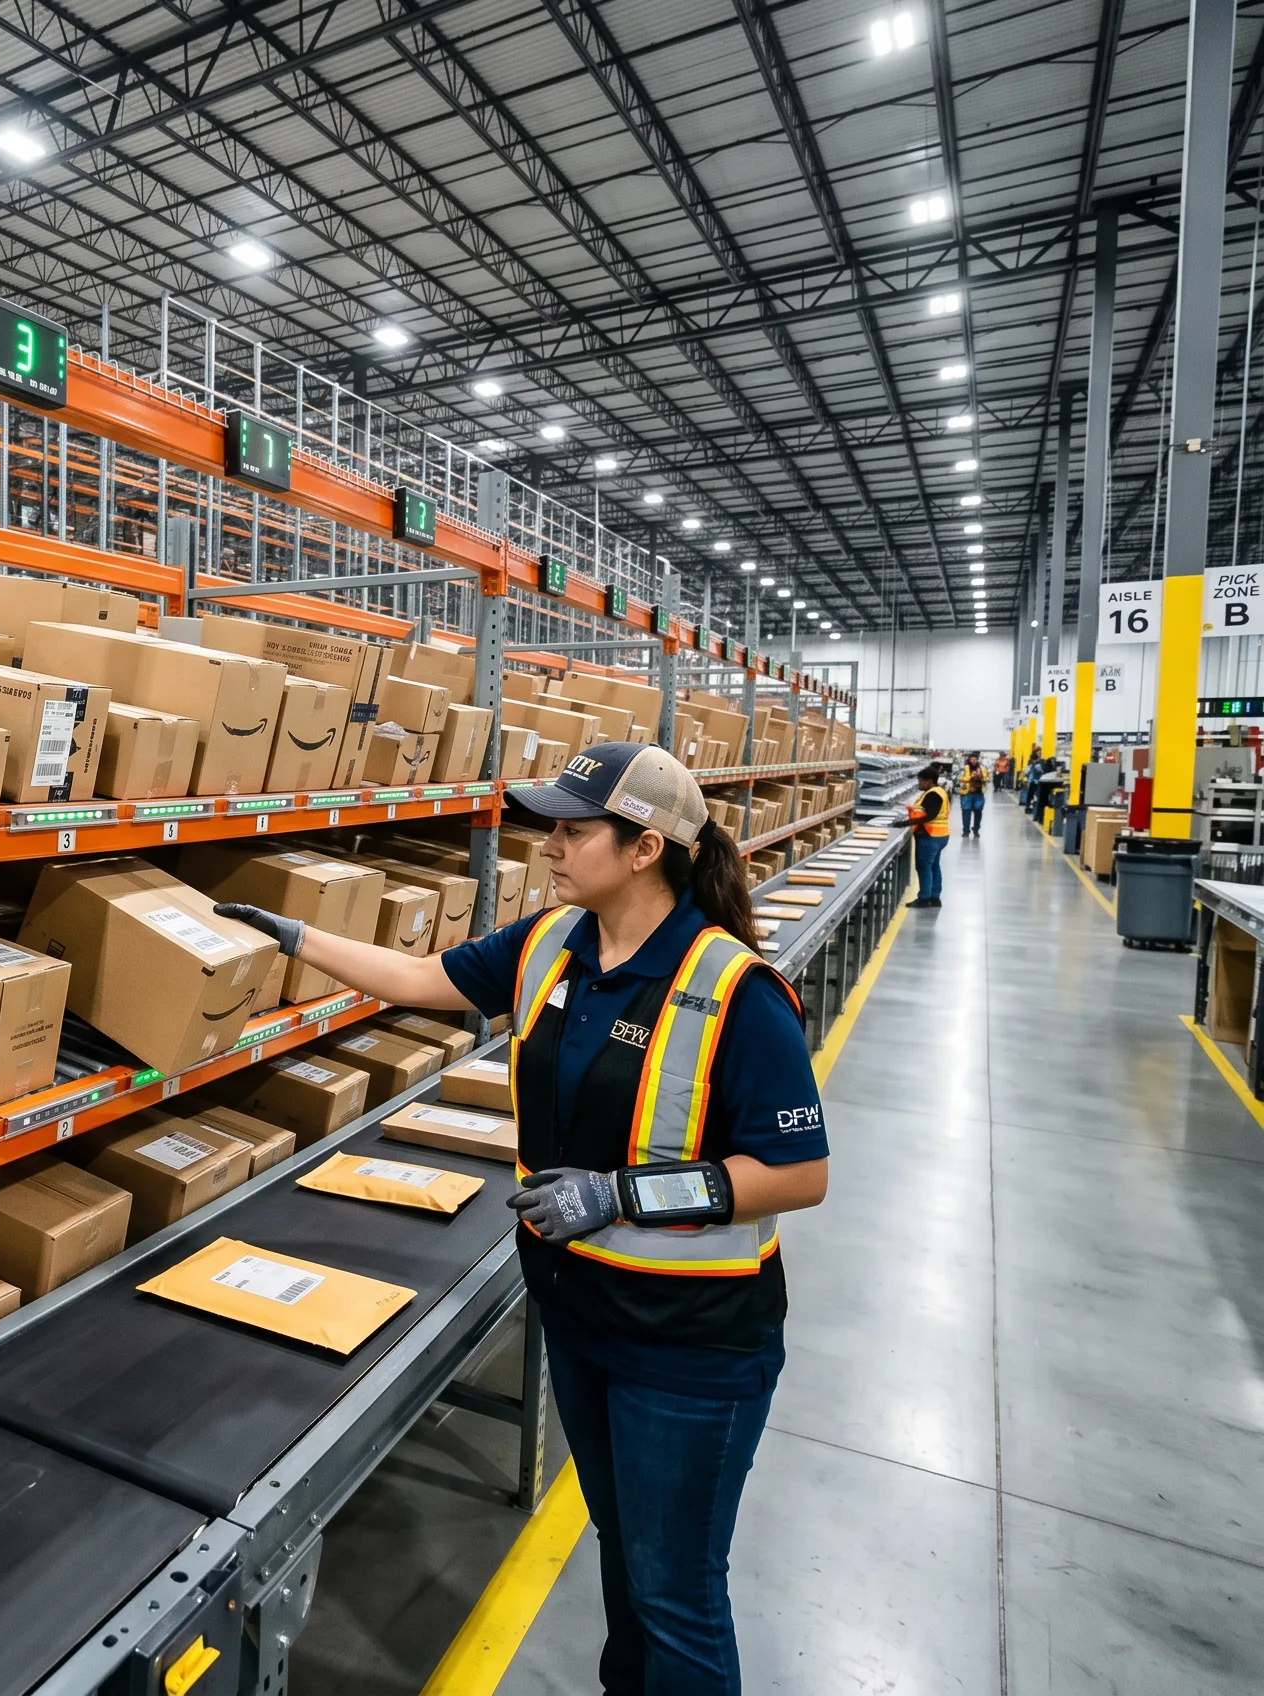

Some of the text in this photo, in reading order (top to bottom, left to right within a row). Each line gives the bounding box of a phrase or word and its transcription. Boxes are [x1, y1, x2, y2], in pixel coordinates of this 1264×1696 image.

[17, 323, 33, 372] 3
[1218, 573, 1258, 586] PICK
[1108, 591, 1152, 602] AISLE
[1213, 585, 1260, 599] ZONE
[1109, 608, 1149, 634] 16
[1225, 603, 1249, 626] B
[1049, 679, 1069, 692] 16
[1105, 679, 1116, 691] B
[1024, 705, 1039, 714] 14
[64, 833, 71, 849] 3
[777, 1104, 819, 1128] DFW
[62, 1121, 69, 1138] 2
